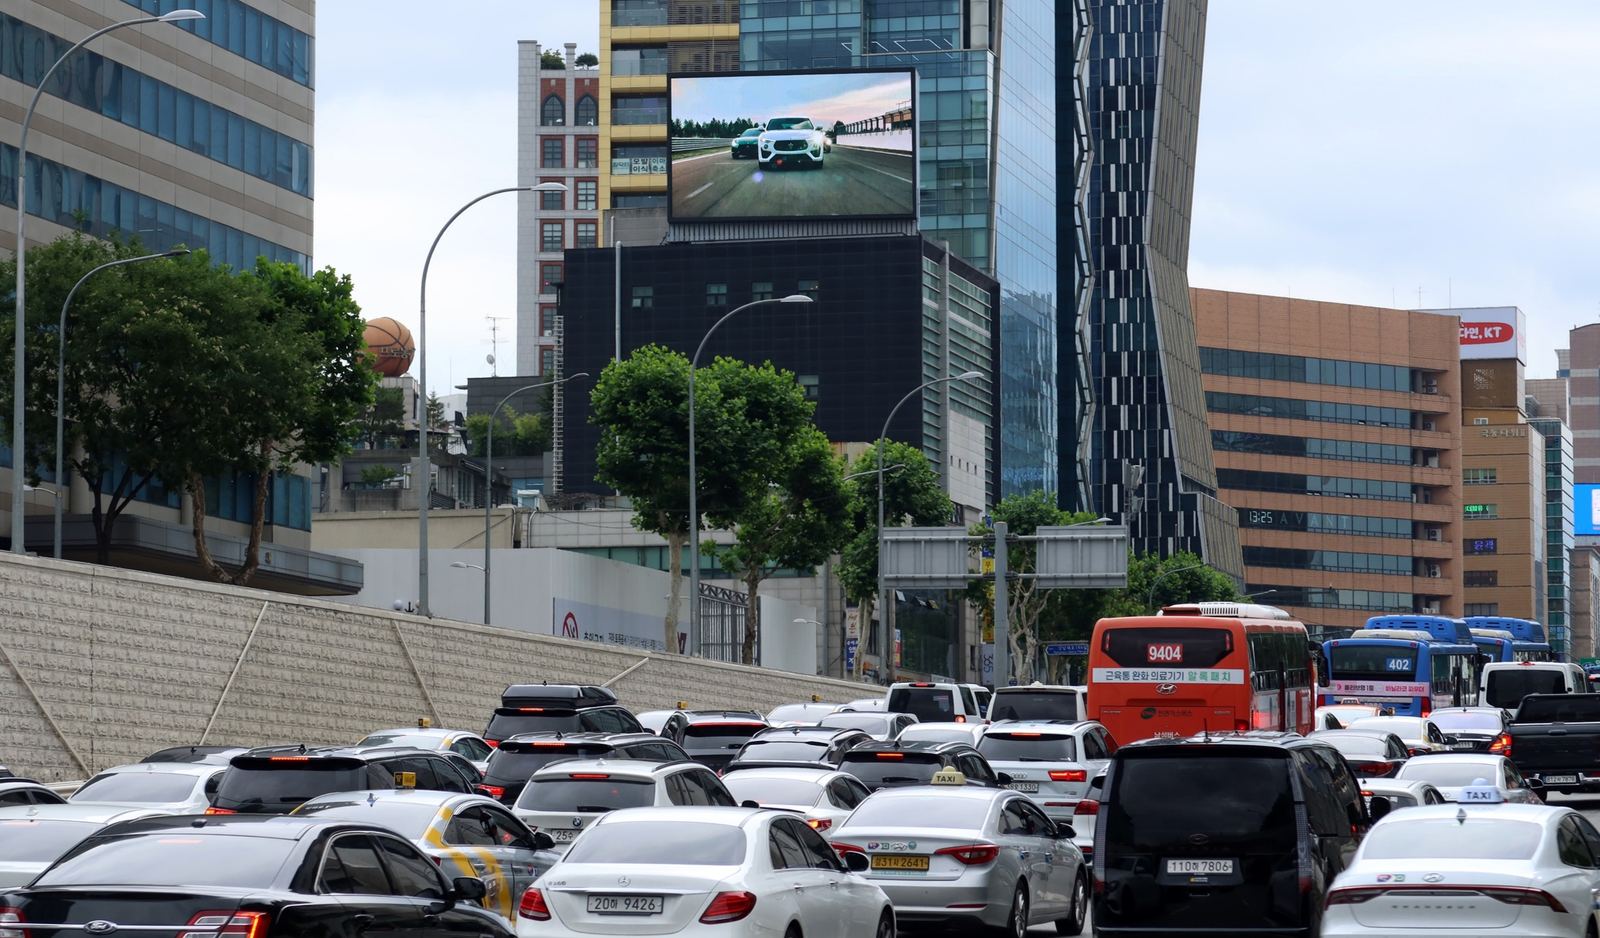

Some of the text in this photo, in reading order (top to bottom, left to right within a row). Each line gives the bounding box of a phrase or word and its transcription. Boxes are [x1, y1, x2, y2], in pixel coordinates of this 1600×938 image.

[1249, 511, 1273, 523] 13:25
[1149, 646, 1181, 660] 9404
[983, 654, 993, 673] 365
[1389, 659, 1409, 670] 402
[1105, 671, 1130, 681] 근육통
[1132, 671, 1149, 681] 완화
[1151, 671, 1185, 681] 의료기기
[936, 775, 956, 783] TAXI
[1466, 791, 1492, 800] TAXI
[901, 857, 924, 868] 2641
[1201, 862, 1229, 872] 7806
[594, 898, 656, 911] 20하 9426
